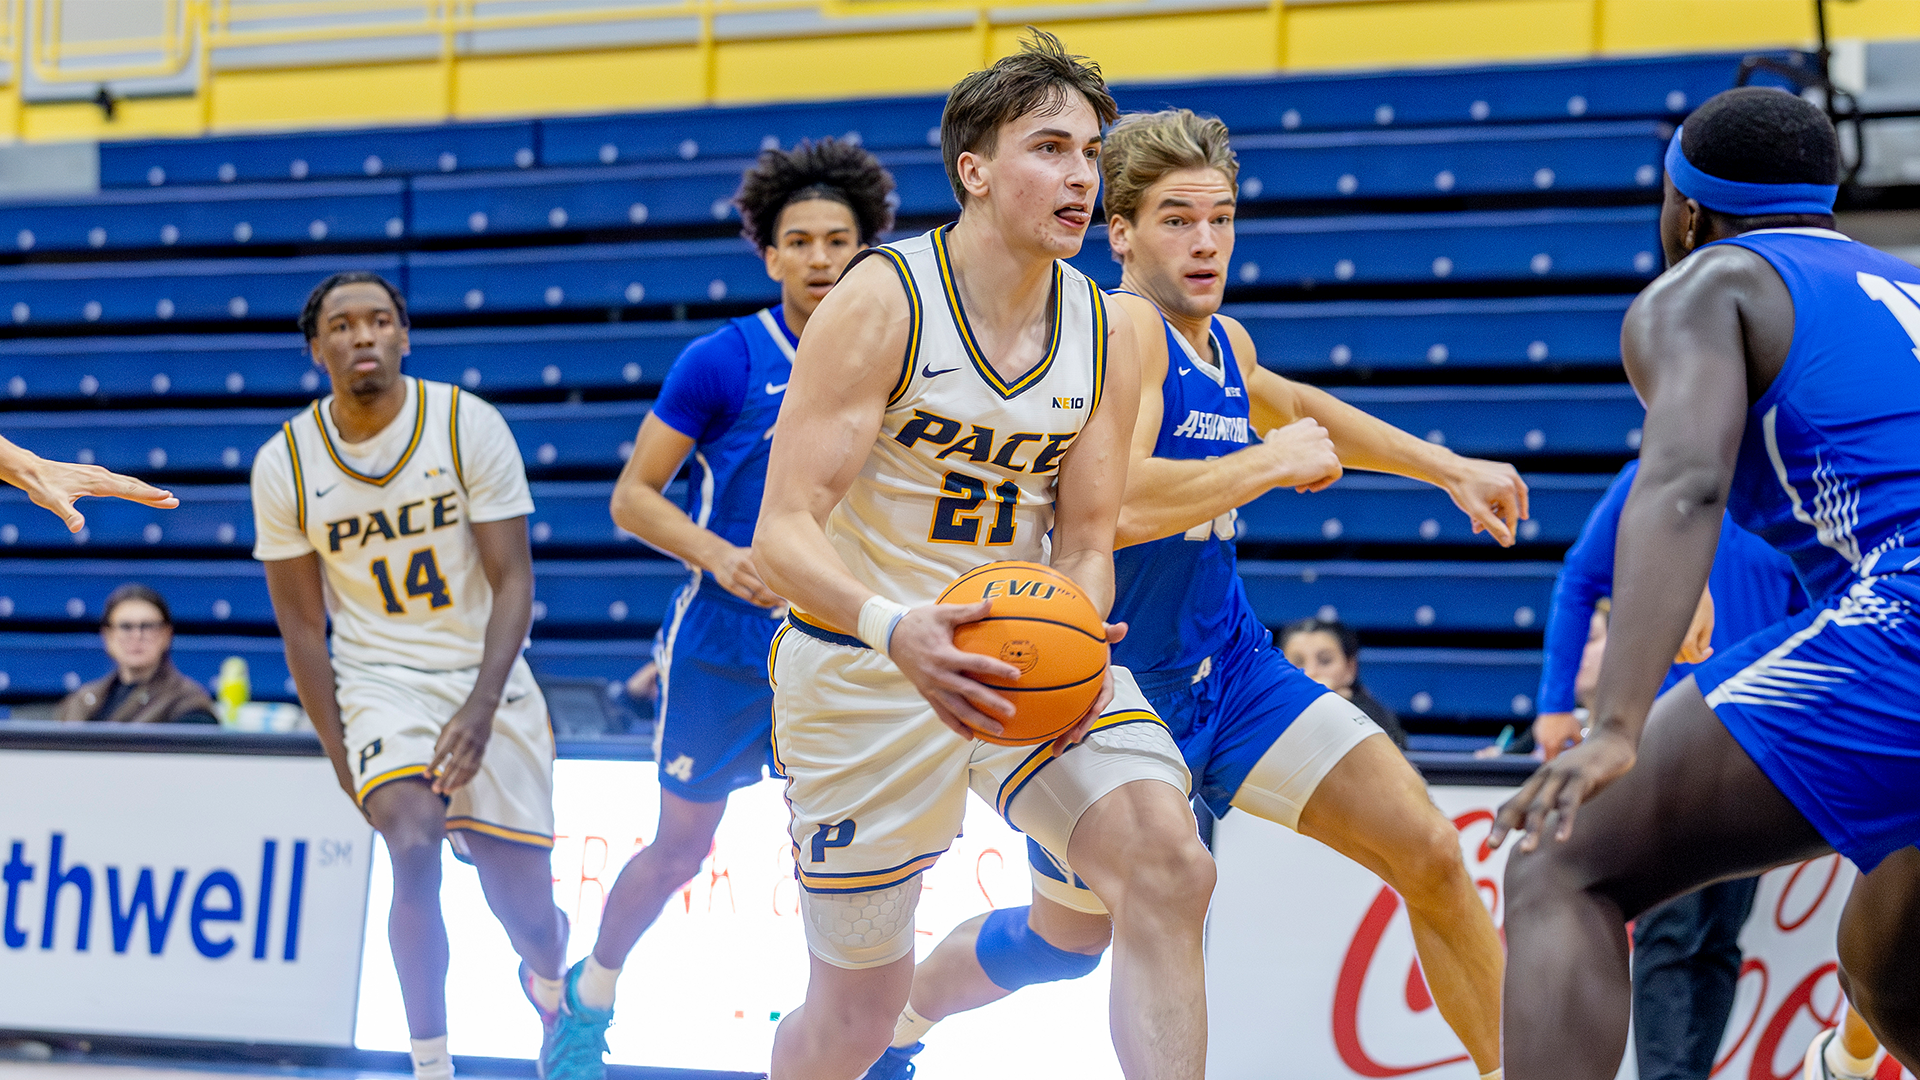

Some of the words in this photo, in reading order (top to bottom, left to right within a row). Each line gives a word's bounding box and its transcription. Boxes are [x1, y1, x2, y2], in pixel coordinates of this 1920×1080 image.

[1856, 271, 1920, 364] 1
[1051, 396, 1084, 410] NE10
[893, 408, 1079, 476] PACE
[325, 490, 459, 553] PACE
[927, 470, 1022, 547] 21
[369, 545, 454, 618] 14
[981, 578, 1057, 602] EVO
[359, 737, 383, 776] P
[809, 818, 858, 864] P
[2, 829, 310, 964] thwell
